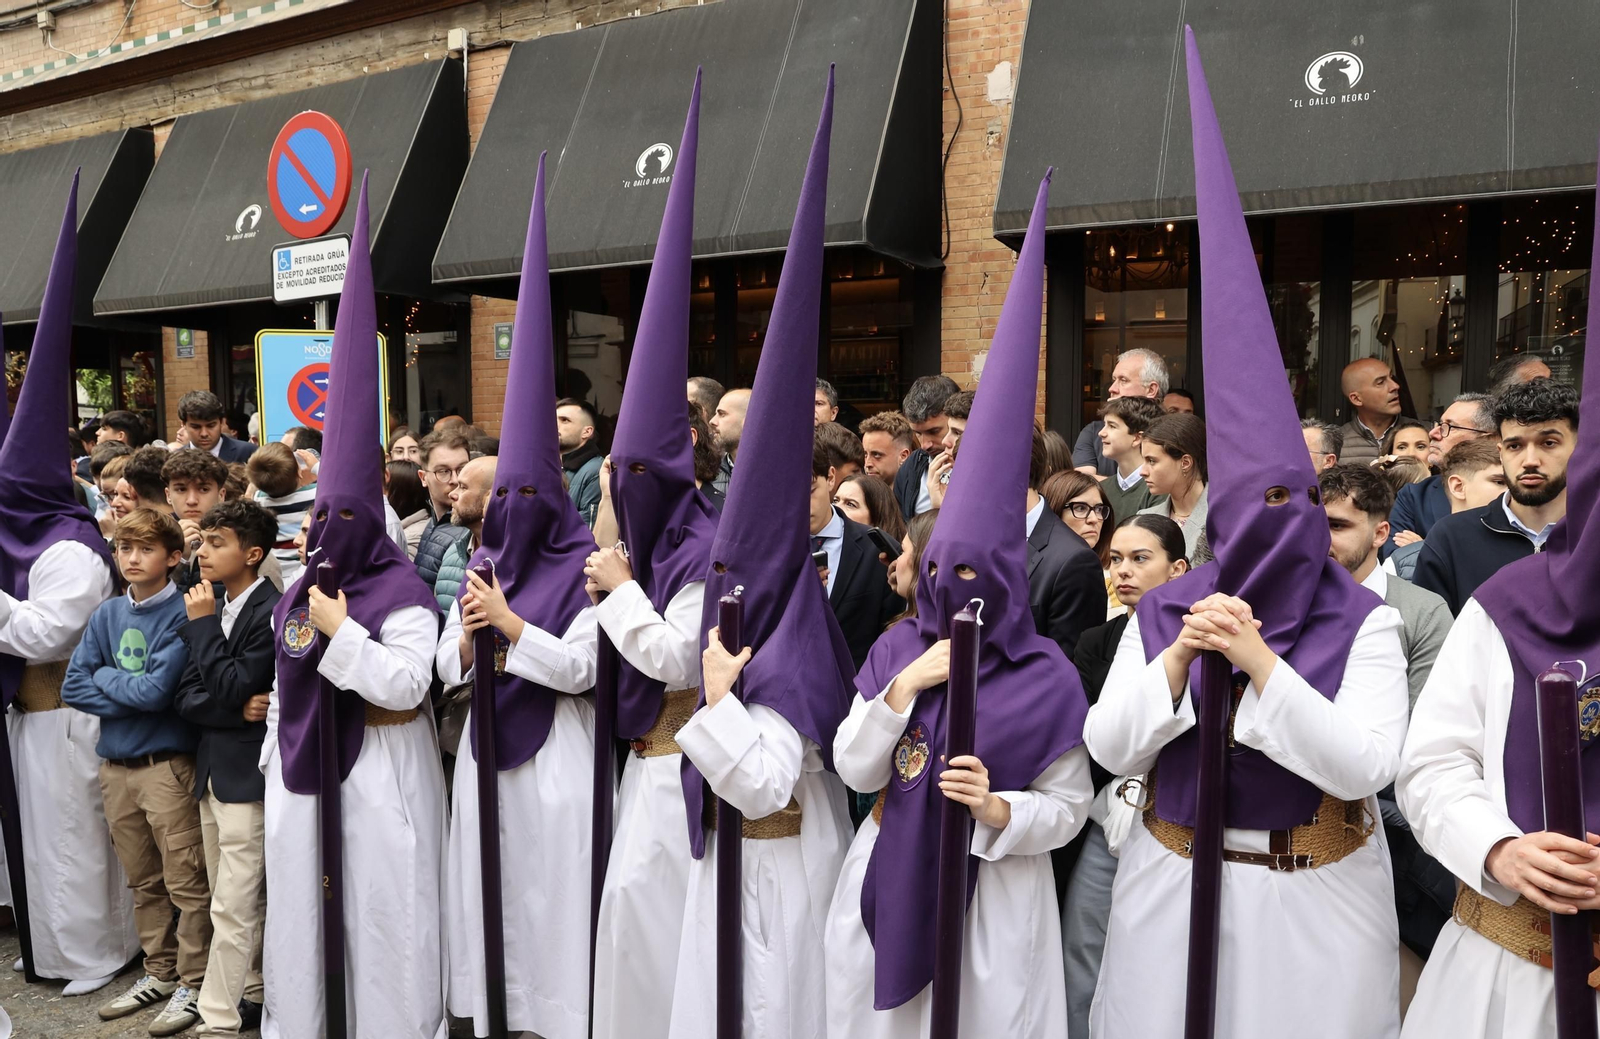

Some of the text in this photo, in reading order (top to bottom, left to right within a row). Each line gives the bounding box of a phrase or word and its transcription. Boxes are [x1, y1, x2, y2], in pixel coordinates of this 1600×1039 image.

[294, 249, 345, 265] RETIRADA GRÚA
[277, 263, 346, 280] EXCEPTO ACREDITADOS
[276, 273, 345, 289] DE MOVILIDAD REDUCID
